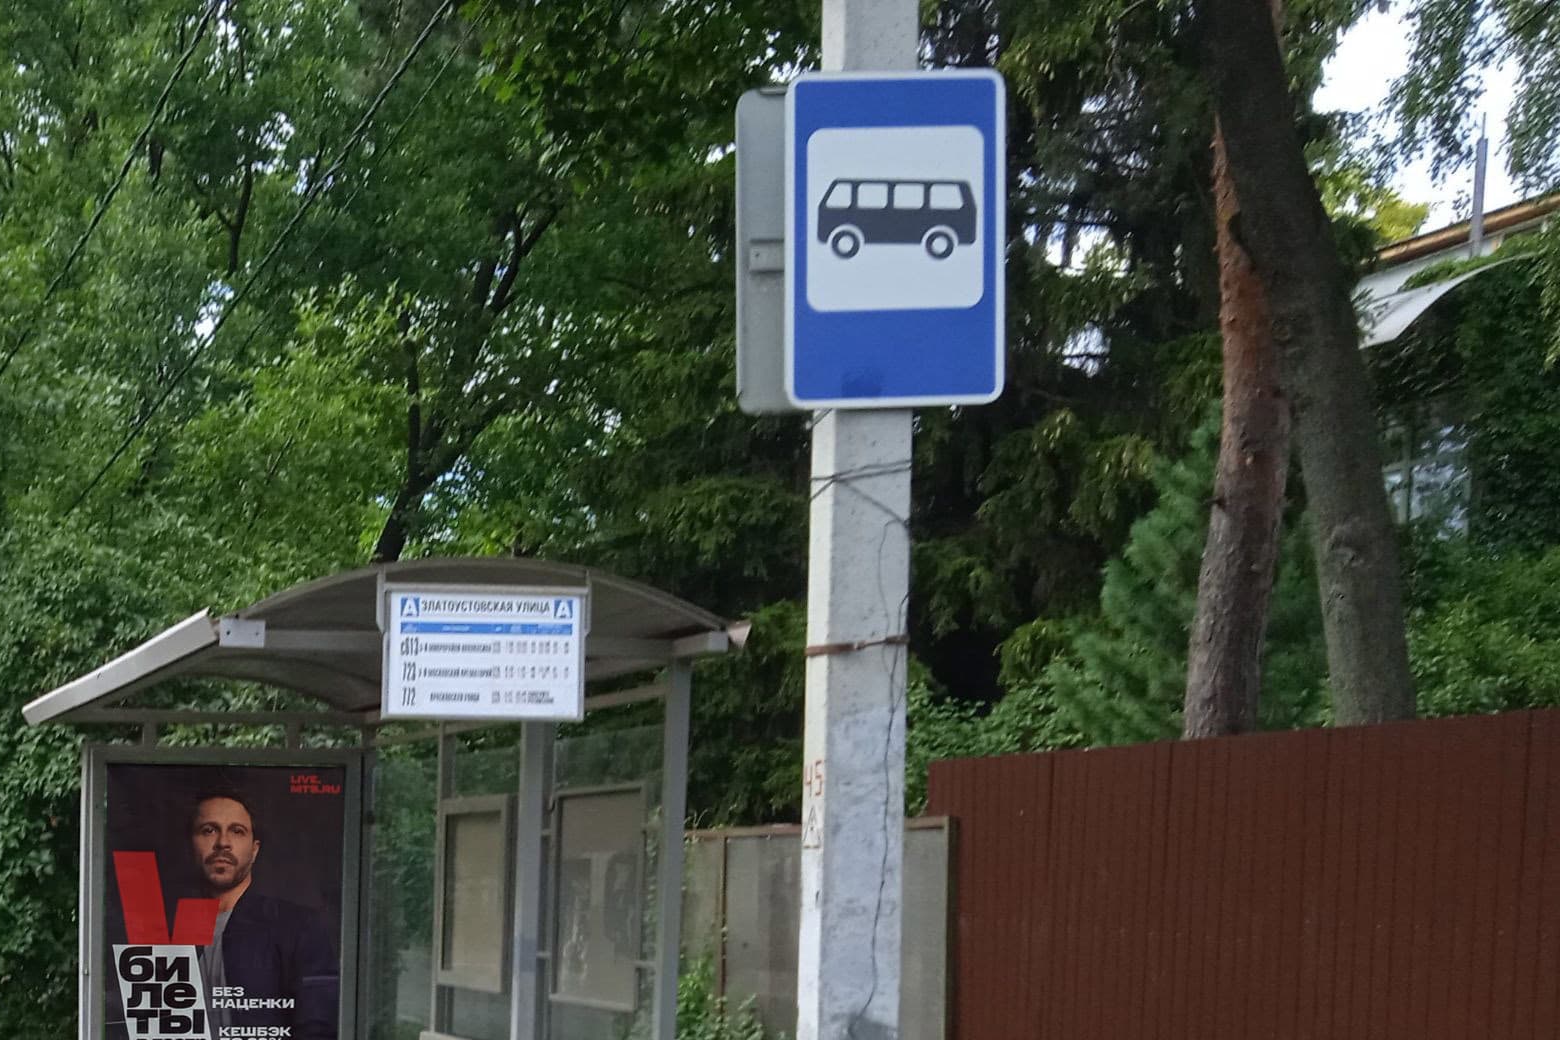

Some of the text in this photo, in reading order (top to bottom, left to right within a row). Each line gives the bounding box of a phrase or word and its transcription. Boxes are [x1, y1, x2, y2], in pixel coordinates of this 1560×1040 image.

[421, 599, 550, 614] ЗЛАТОУСТОВСКАЯ УЛИЦА
[119, 946, 190, 982] би
[127, 982, 197, 1009] ле
[212, 986, 245, 997] БЕЗ
[212, 998, 295, 1011] НАЦЕНКИ
[127, 1009, 205, 1034] ты
[218, 1026, 291, 1037] КЕШБЭК
